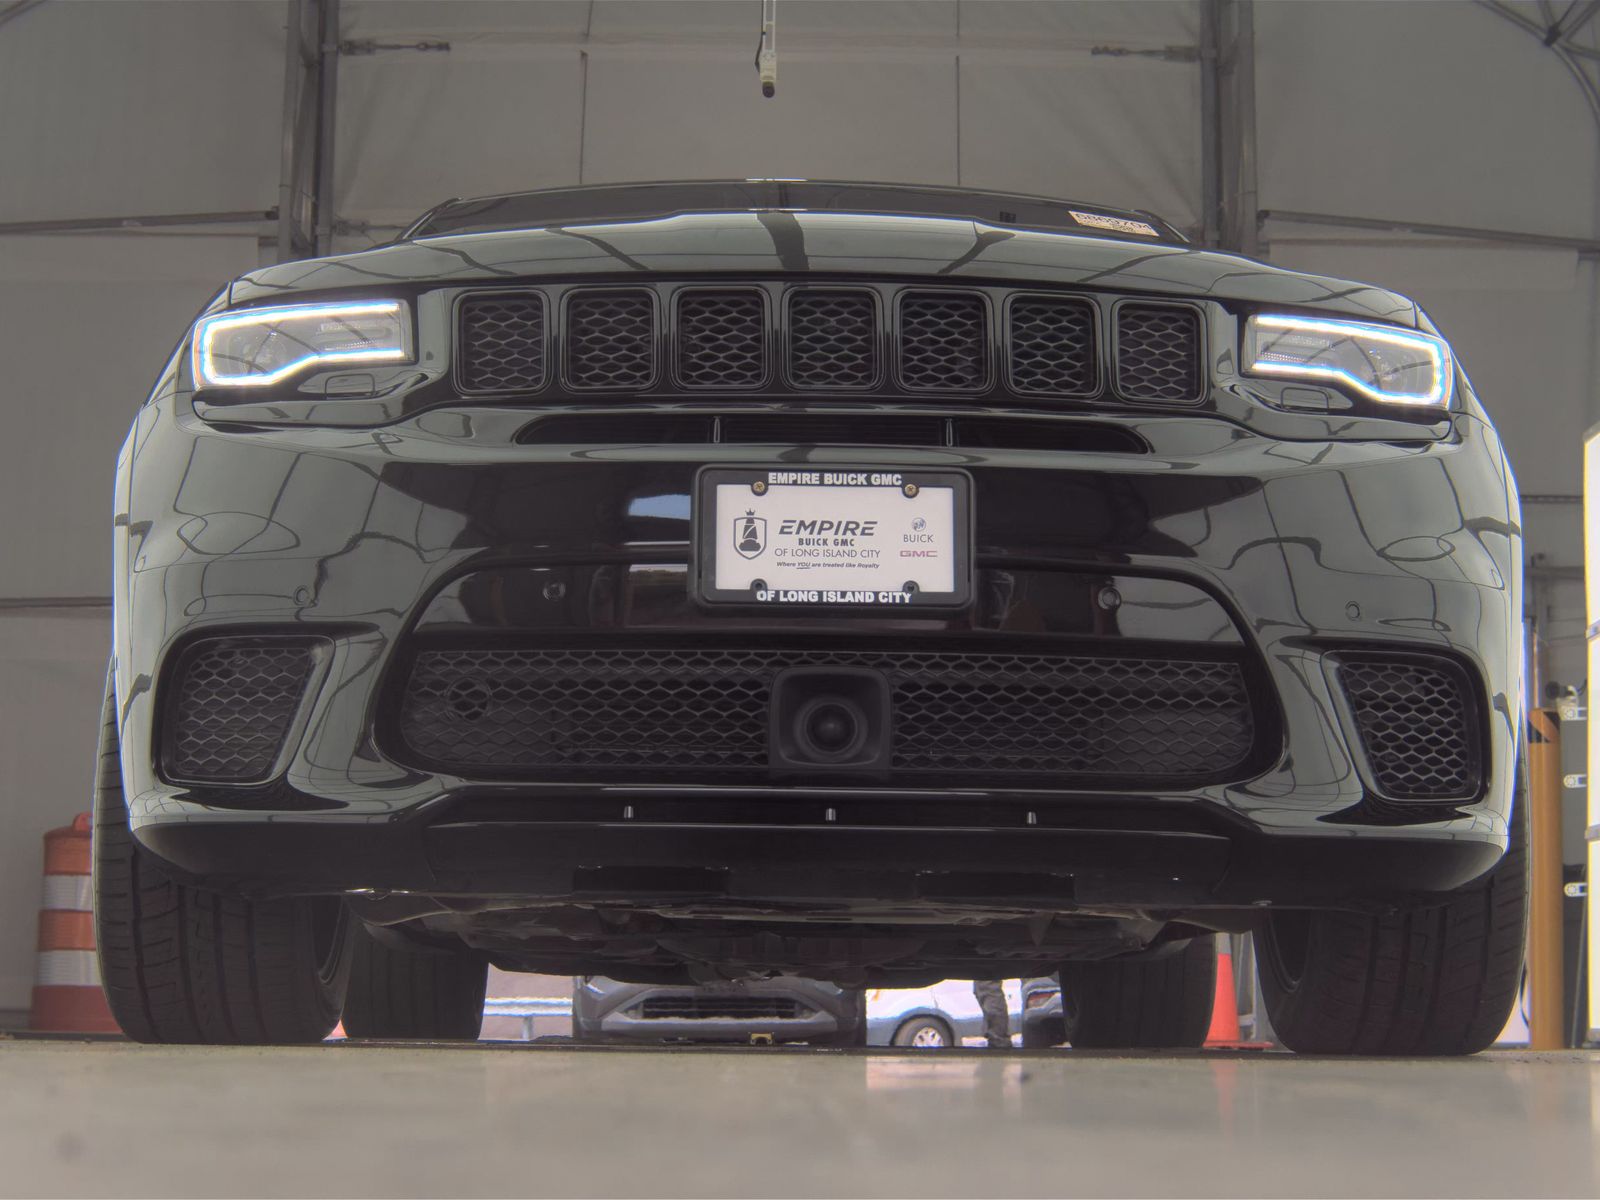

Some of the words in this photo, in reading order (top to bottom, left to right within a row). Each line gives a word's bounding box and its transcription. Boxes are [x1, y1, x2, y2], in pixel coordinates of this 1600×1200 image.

[768, 472, 820, 484] EMPIRE
[824, 473, 869, 485] BUICK
[873, 474, 902, 485] GMC
[779, 520, 877, 536] EMPIRE
[799, 538, 828, 546] BUICK
[904, 534, 934, 542] BUICK
[775, 548, 788, 556] OF
[792, 549, 820, 557] LONG
[823, 549, 857, 557] ISLAND
[860, 550, 880, 558] CITY
[900, 550, 937, 558] GMC
[757, 591, 777, 602] OF
[780, 591, 818, 602] LONG
[823, 591, 875, 603] ISLAND
[878, 592, 912, 603] CITY
